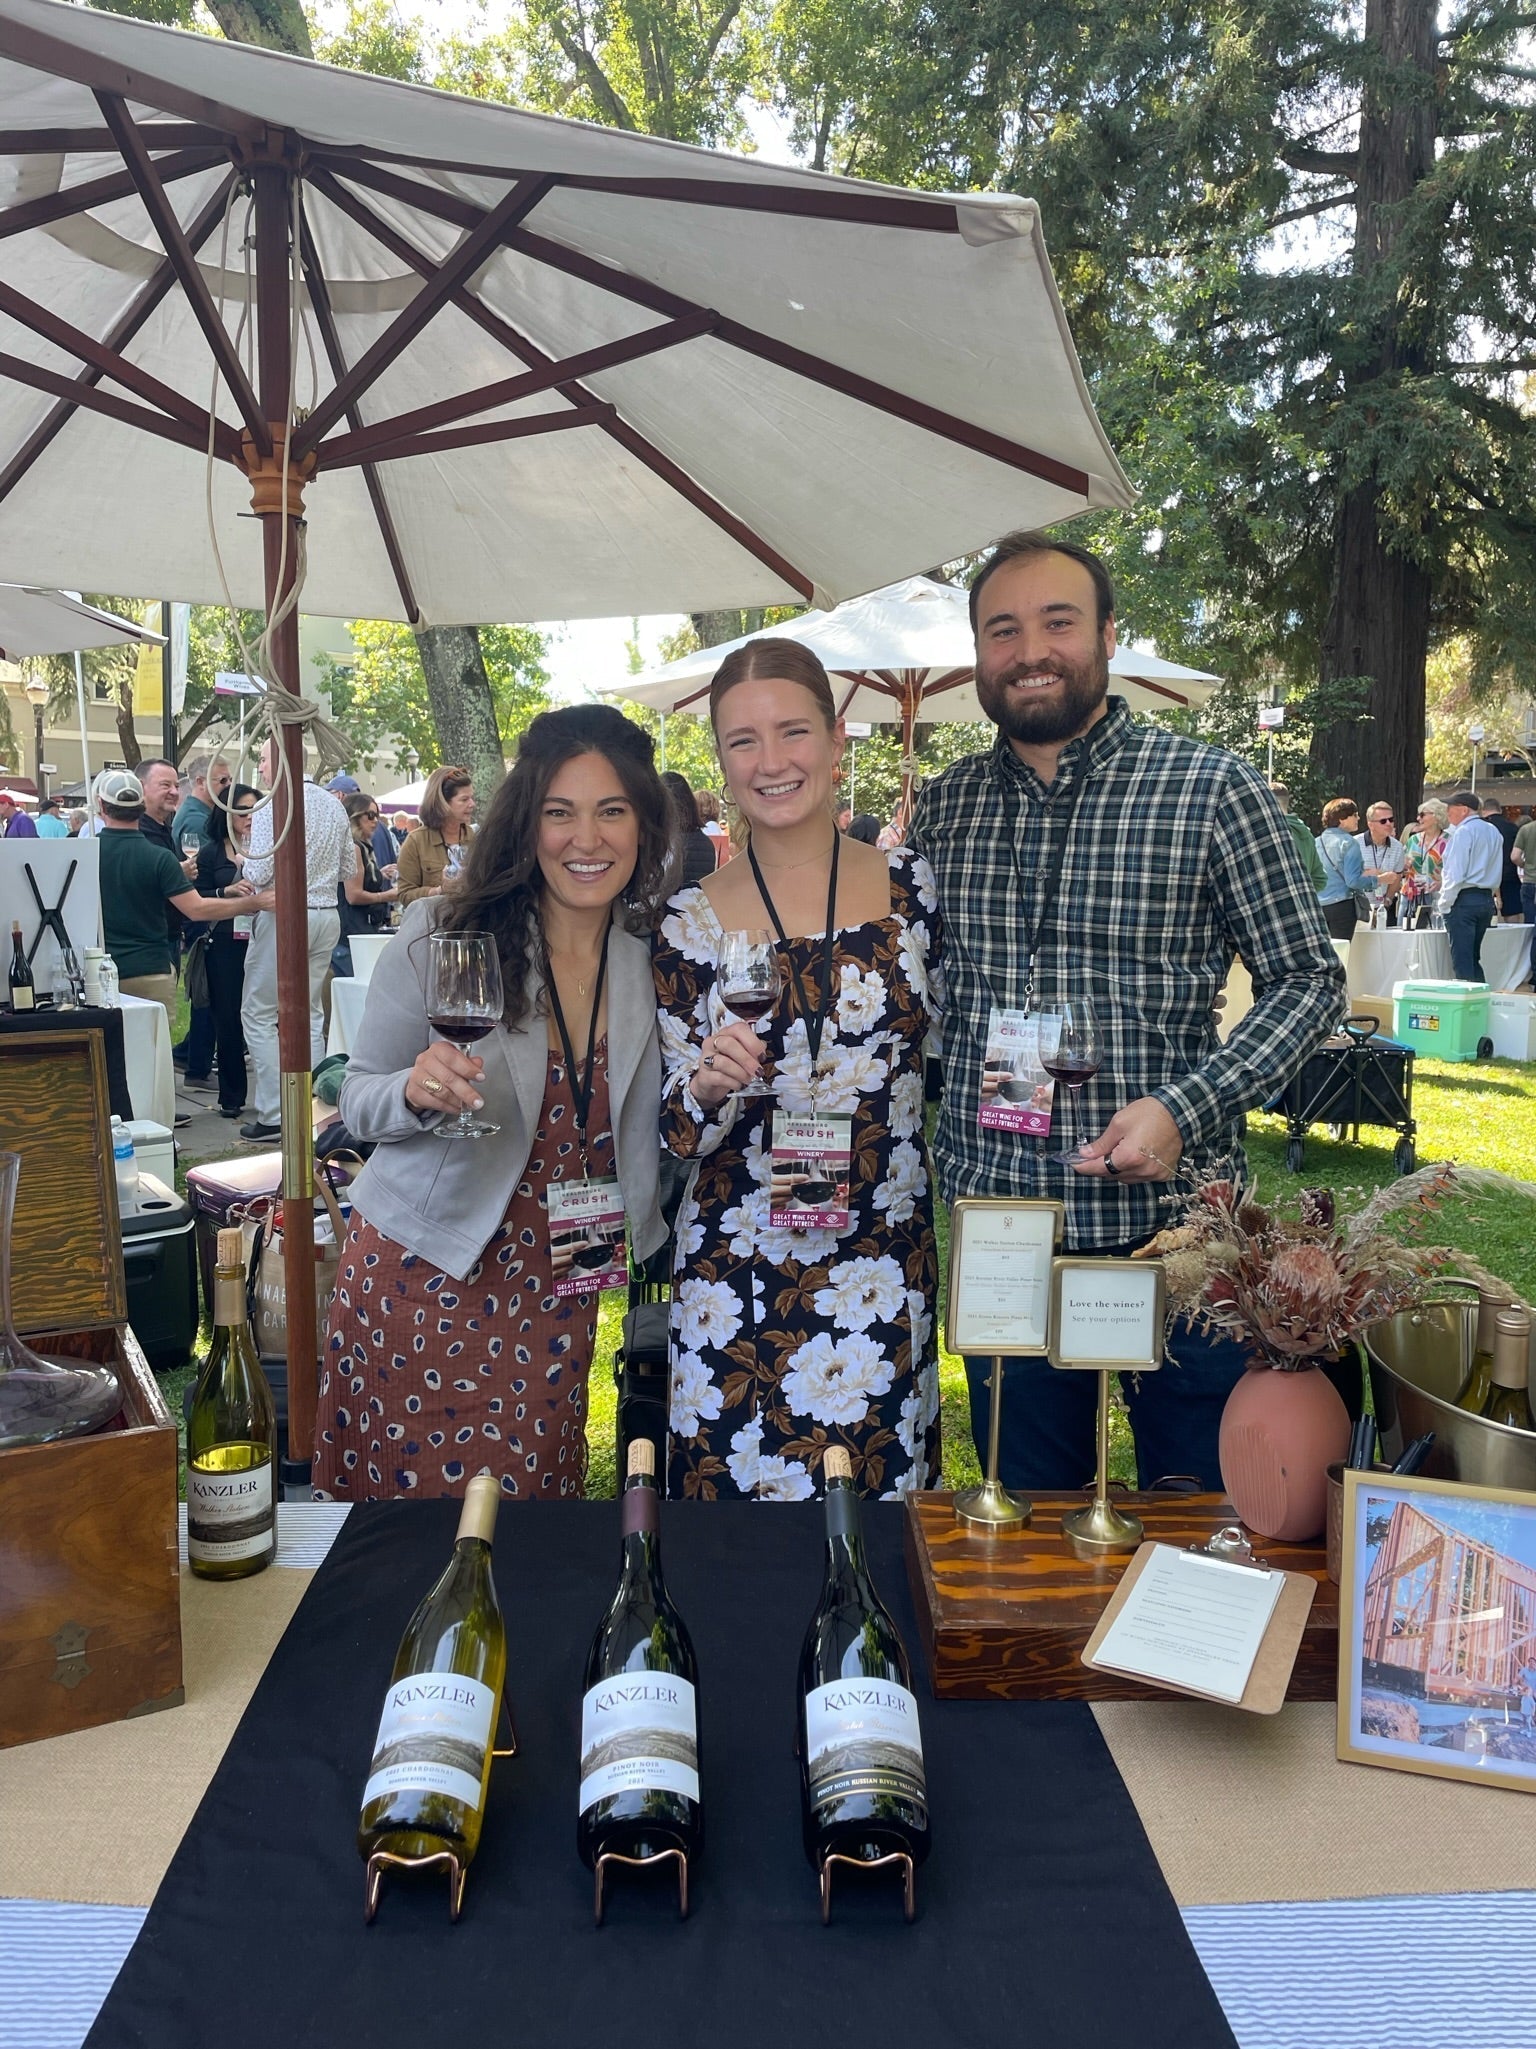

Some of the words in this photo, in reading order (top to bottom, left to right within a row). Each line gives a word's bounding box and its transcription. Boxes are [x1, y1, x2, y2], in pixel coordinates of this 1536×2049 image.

[1410, 1003, 1439, 1011] IGLOO
[982, 1110, 998, 1118] GREAT
[981, 1117, 998, 1125] GREAT
[786, 1129, 835, 1139] CRUSH
[561, 1194, 609, 1207] CRUSH
[574, 1216, 601, 1225] WINERY
[556, 1282, 574, 1290] GREAT
[557, 1288, 574, 1297] GREAT
[1070, 1300, 1091, 1308] Love
[1095, 1300, 1110, 1308] the
[1113, 1300, 1145, 1308] wines?
[1110, 1316, 1141, 1324] options
[193, 1480, 258, 1498] KANZLER
[392, 1685, 476, 1709] KANZLER
[594, 1686, 679, 1714] KANZLER
[823, 1690, 908, 1714] KANZLER
[612, 1762, 636, 1772] PINOT
[816, 1784, 834, 1798] PINOT
[834, 1780, 851, 1790] NOIR
[851, 1778, 878, 1786] RUSSIAN
[879, 1778, 898, 1787] RIVER
